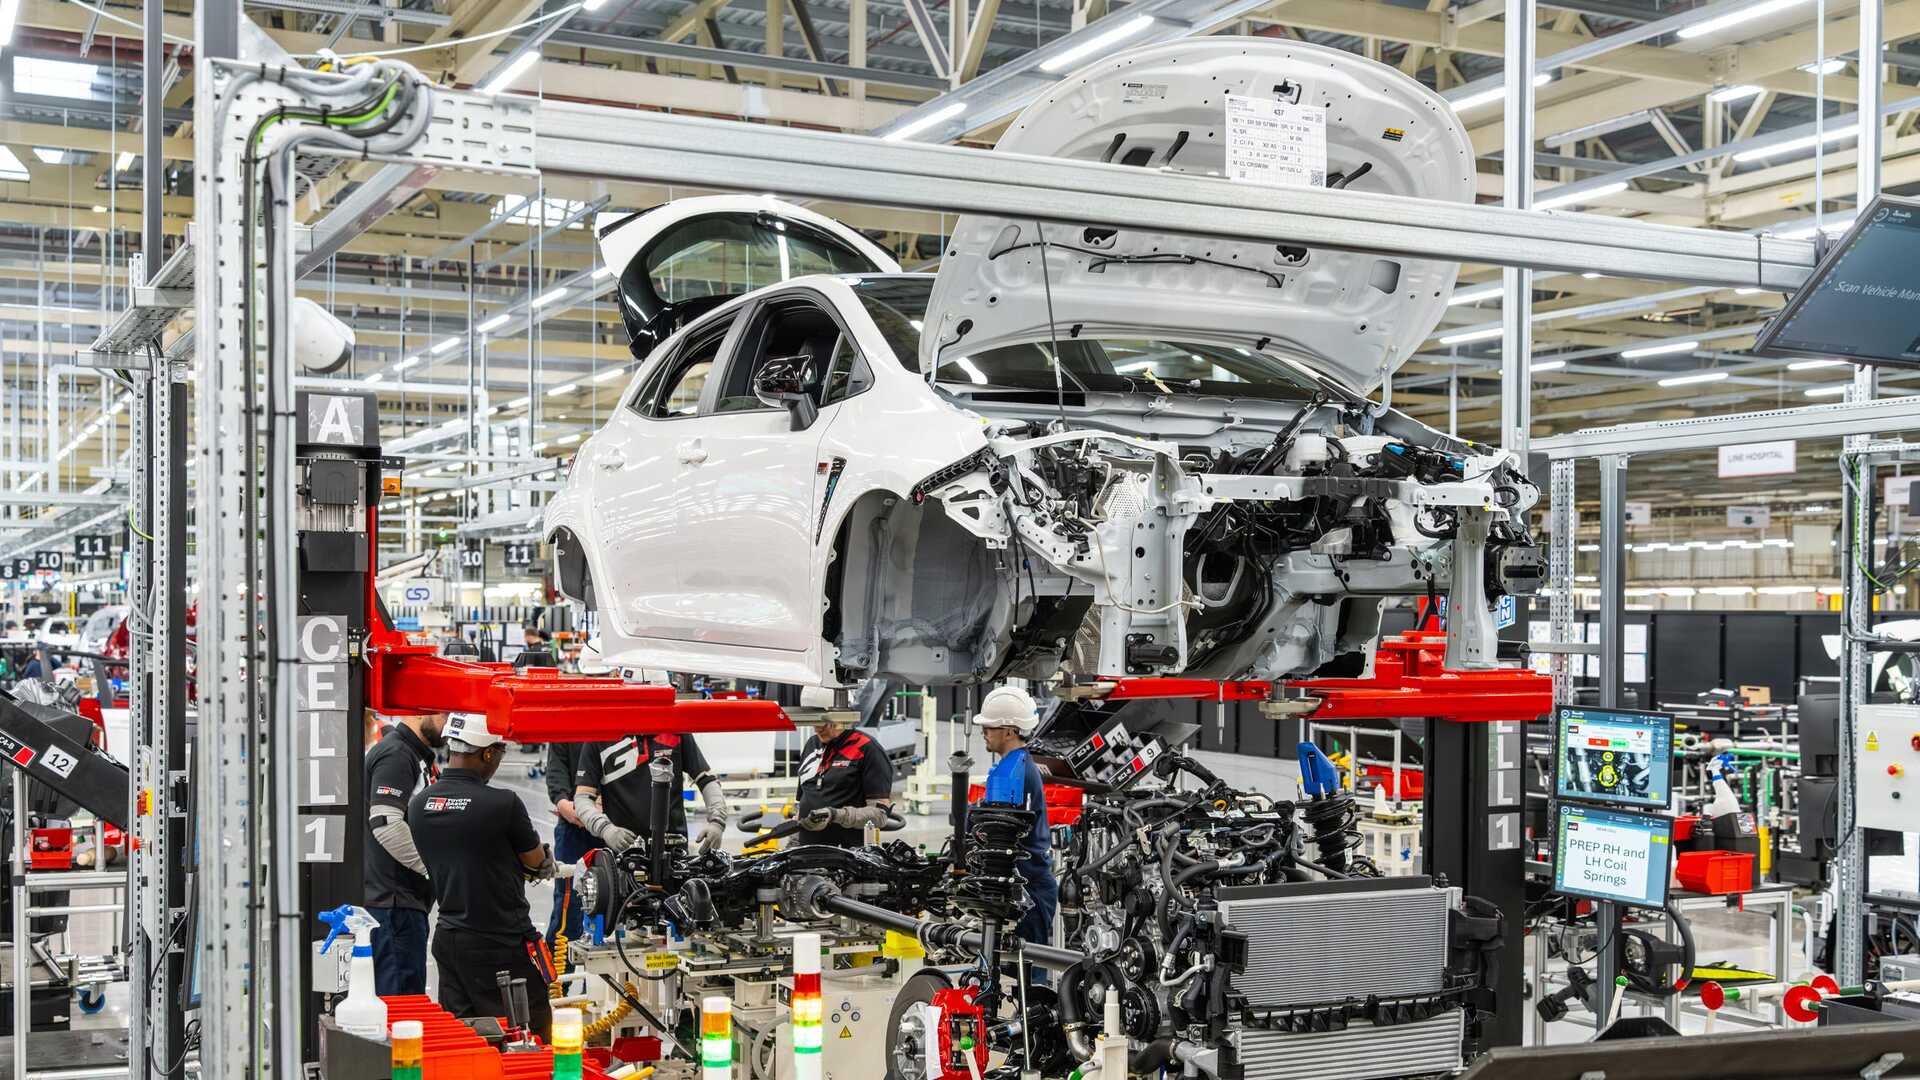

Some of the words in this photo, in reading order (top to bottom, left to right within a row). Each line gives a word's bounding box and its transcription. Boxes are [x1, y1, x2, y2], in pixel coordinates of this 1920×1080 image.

[1834, 280, 1860, 294] Scan
[1862, 284, 1898, 298] Vehicle
[316, 396, 354, 443] A
[1728, 454, 1745, 463] LINE
[1746, 450, 1783, 461] HOSPITAL
[79, 537, 107, 556] 11
[508, 546, 531, 563] 11
[19, 559, 30, 573] 9
[38, 553, 61, 568] 10
[462, 551, 481, 566] 10
[4, 566, 13, 578] 8
[302, 617, 340, 804] CELL
[1111, 731, 1125, 743] 11
[1145, 747, 1155, 758] 9
[48, 753, 70, 772] 12
[424, 802, 444, 811] GR
[304, 817, 333, 861] 1
[1495, 815, 1513, 849] 1
[1569, 839, 1601, 850] PREP
[1603, 843, 1621, 855] RH
[1623, 848, 1645, 859] and
[1585, 856, 1601, 867] LH
[1604, 858, 1627, 871] Coil
[1583, 870, 1626, 886] Springs
